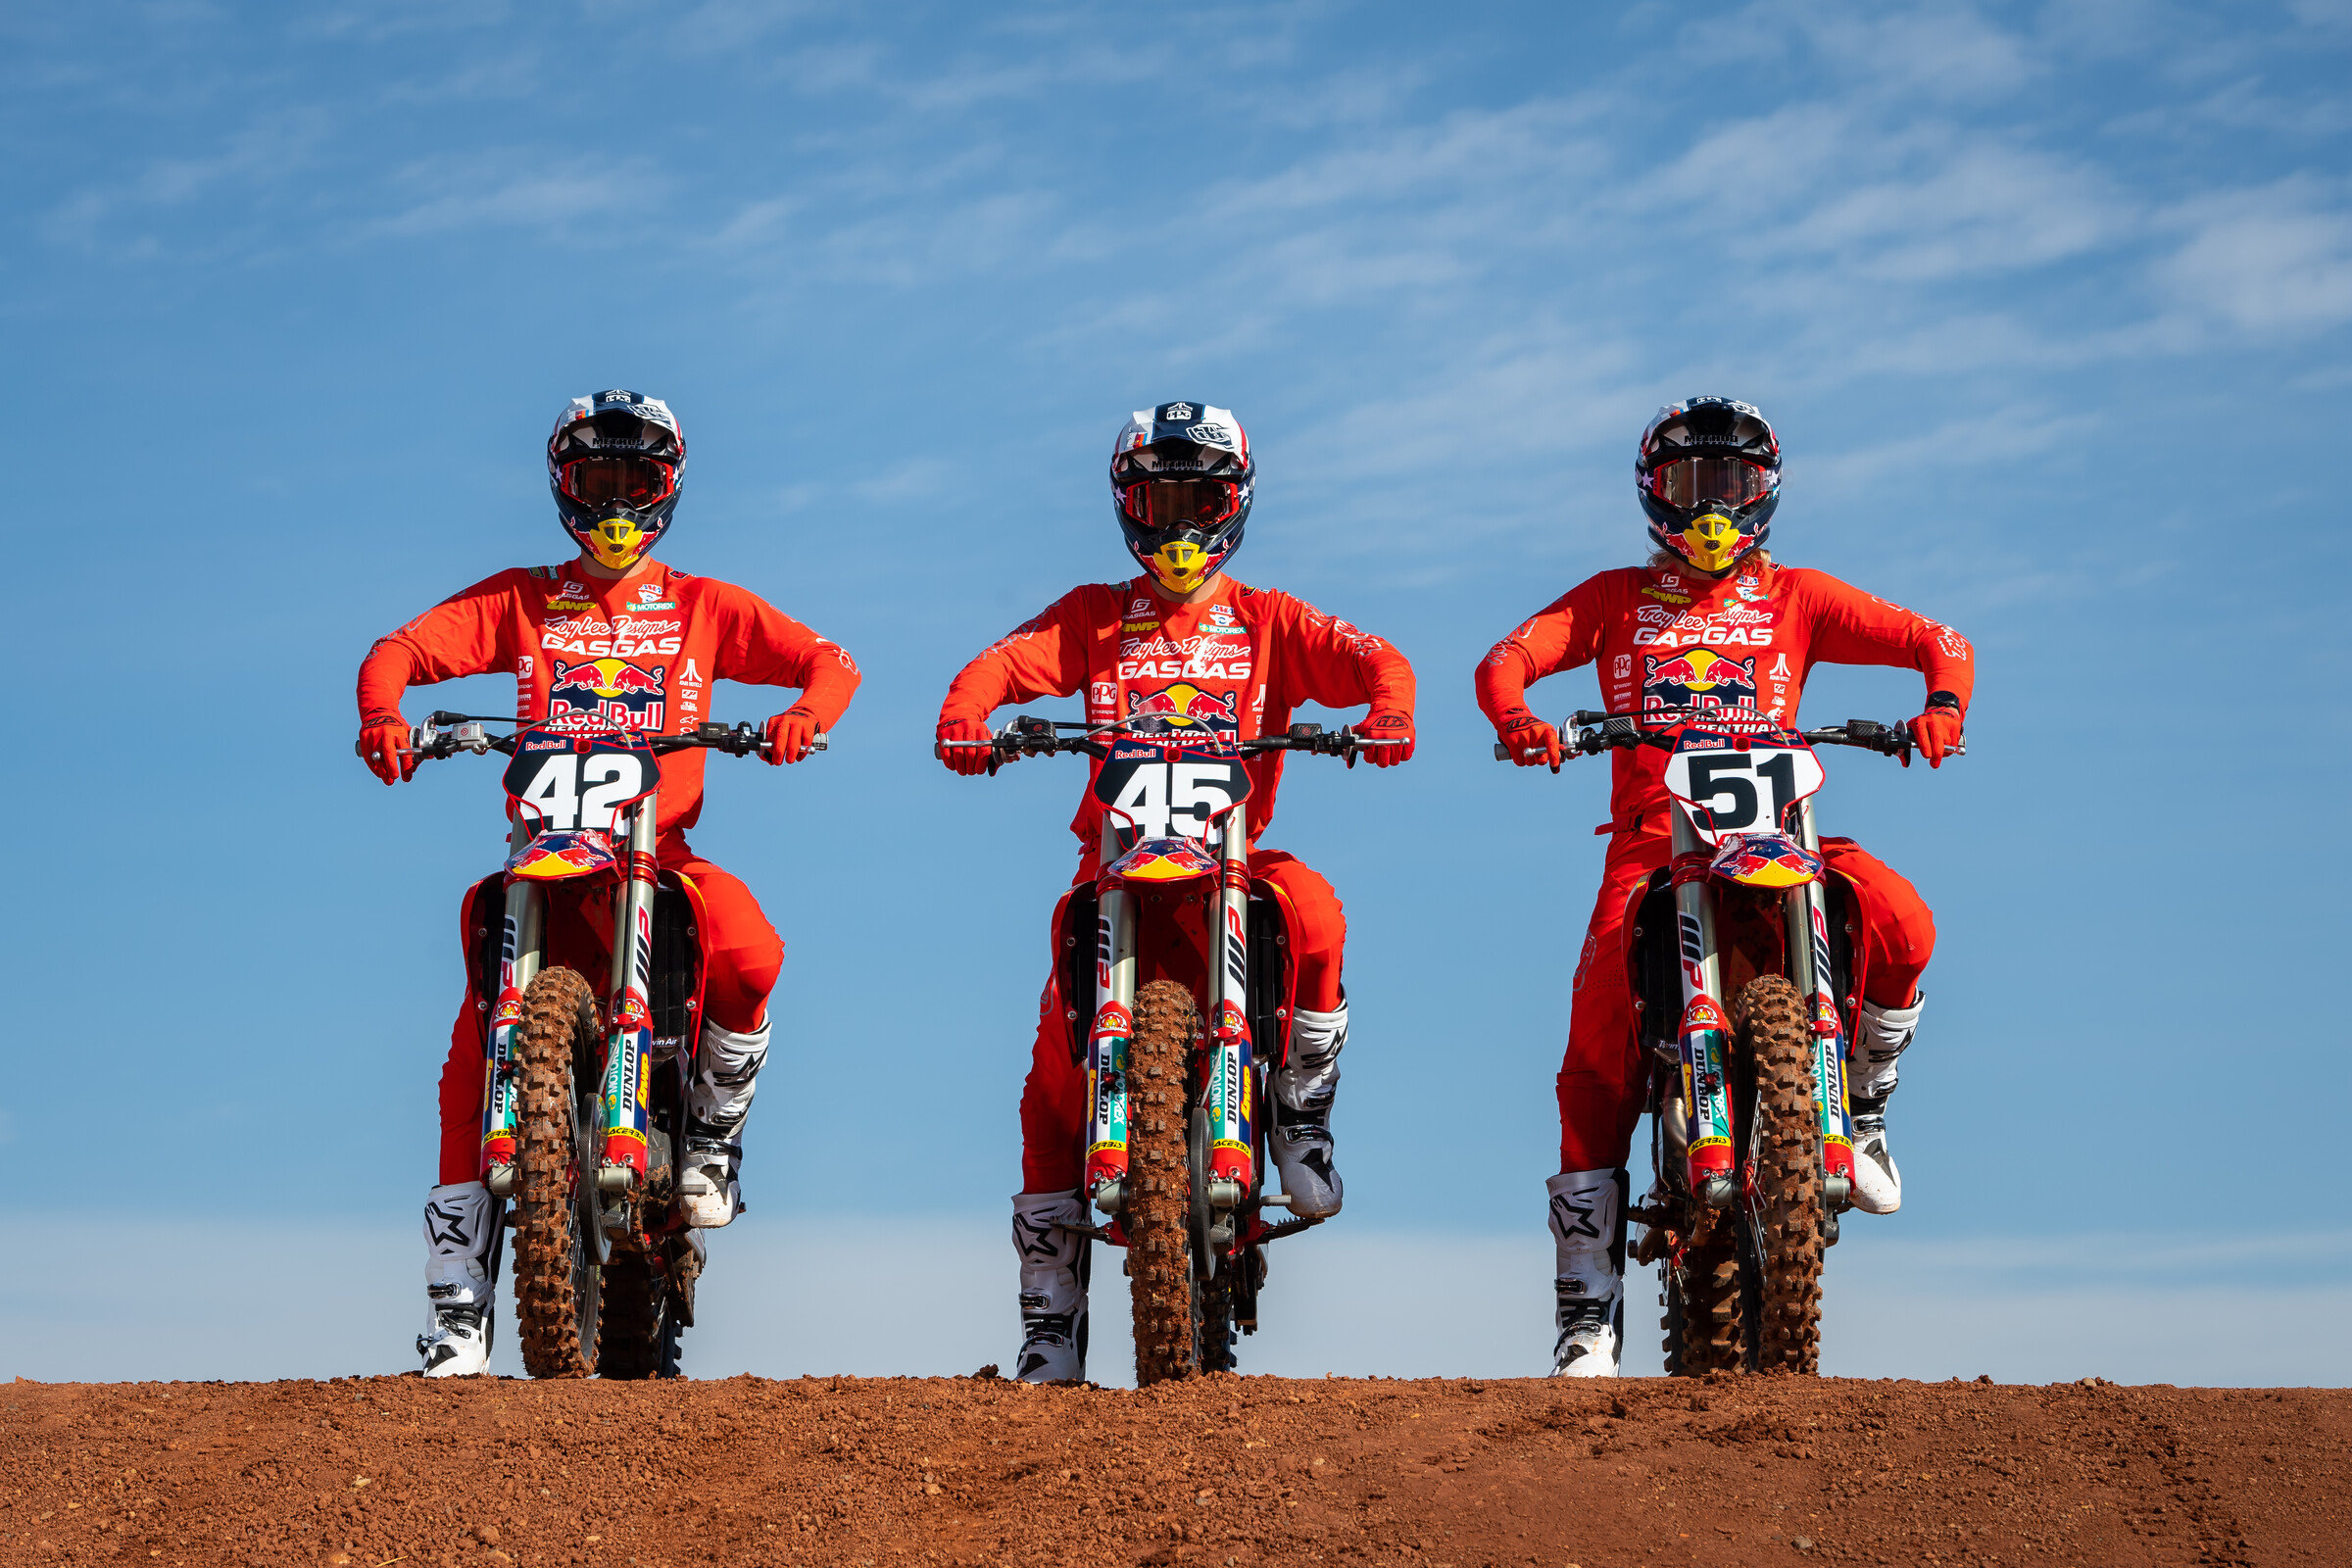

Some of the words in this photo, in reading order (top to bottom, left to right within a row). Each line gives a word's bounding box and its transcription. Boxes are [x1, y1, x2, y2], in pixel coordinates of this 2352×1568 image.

[637, 602, 674, 611] MOTOREX
[1122, 611, 1156, 619] GASGAS
[1209, 605, 1235, 614] AMA
[1638, 605, 1675, 628] Troy
[1673, 610, 1706, 629] Lee
[1706, 609, 1773, 627] signs
[545, 615, 580, 638] Troy
[577, 615, 611, 636] Lee
[612, 614, 681, 639] Designs
[541, 633, 682, 658] GASGAS
[1119, 637, 1152, 660] Troy
[1151, 636, 1181, 656] Lee
[1633, 627, 1773, 648] GASGAS
[1118, 661, 1251, 680] GASGAS
[1614, 658, 1631, 676] PPG
[1093, 684, 1116, 702] PPG
[551, 699, 608, 726] Red
[609, 700, 663, 731] Bull
[1643, 694, 1700, 724] Red
[1701, 695, 1755, 717] Bull
[526, 741, 546, 751] Red
[546, 740, 566, 750] Bull
[1115, 750, 1136, 760] Red
[1136, 749, 1156, 759] Bull
[1684, 740, 1704, 750] Red
[1704, 738, 1725, 749] Bull
[519, 754, 642, 834] 42
[1109, 762, 1234, 843] 45
[1688, 753, 1797, 832] 51
[623, 1039, 635, 1112] DUNLOP
[1826, 1045, 1839, 1119] DUNLOP
[1227, 1052, 1238, 1124] DUNLOP
[483, 1129, 511, 1145] ACERB
[1690, 1137, 1727, 1153] ACERBIS
[1088, 1141, 1122, 1156] ACERBIS
